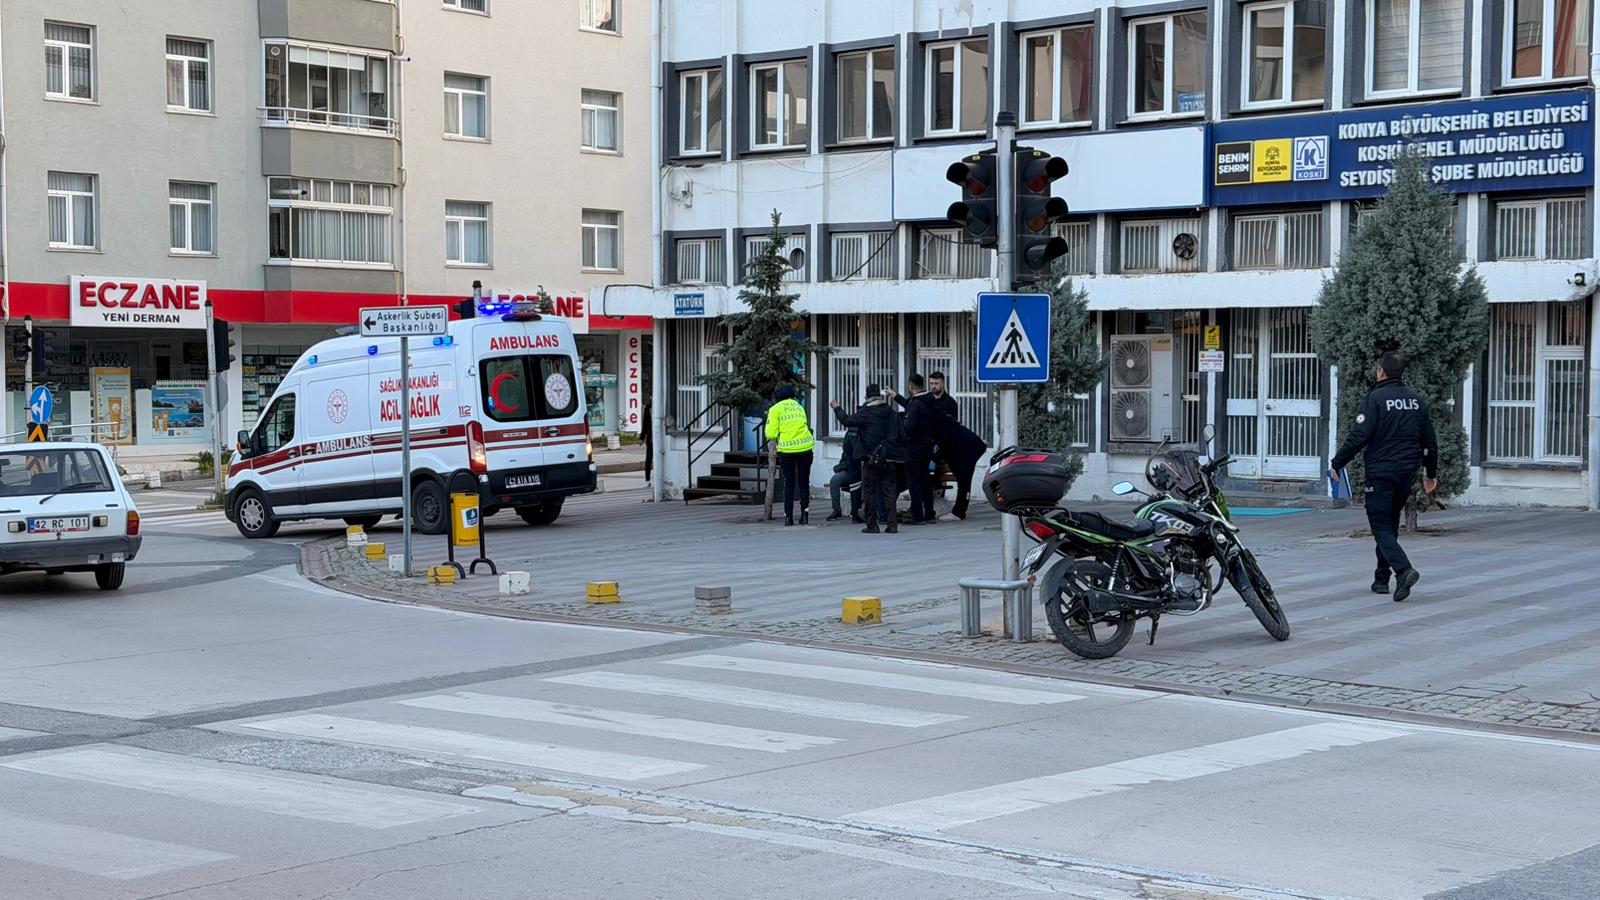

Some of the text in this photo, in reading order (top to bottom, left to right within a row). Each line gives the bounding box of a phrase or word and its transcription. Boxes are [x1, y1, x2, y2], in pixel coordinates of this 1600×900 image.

[1338, 102, 1588, 140] KONYA BÜYÜKŞEHİR BELEDİYESİ
[1358, 140, 1402, 162] KOSKİ
[1459, 128, 1565, 155] MÜDÜRLÜĞÜ
[1218, 152, 1249, 164] BENİM
[1303, 148, 1316, 166] K
[1218, 163, 1249, 175] ŞEHRİM
[1298, 171, 1322, 179] KOSKİ
[1432, 164, 1474, 185] ŞUBE
[1477, 152, 1584, 179] MÜDÜRLÜĞÜ
[80, 282, 200, 310] ECZANE
[102, 312, 180, 323] YENİ DERMAN
[377, 310, 443, 321] Askerlik Şubesi
[383, 321, 438, 333] Başkanlığı
[490, 334, 559, 350] AMBULANS
[407, 371, 439, 390] AKANLIĞI
[629, 337, 638, 424] eczane
[410, 391, 441, 419] AĞLIK
[458, 405, 471, 417] 112
[1386, 398, 1419, 411] POLİS
[315, 435, 370, 454] AMBULANS
[35, 518, 86, 529] 42 RC 101
